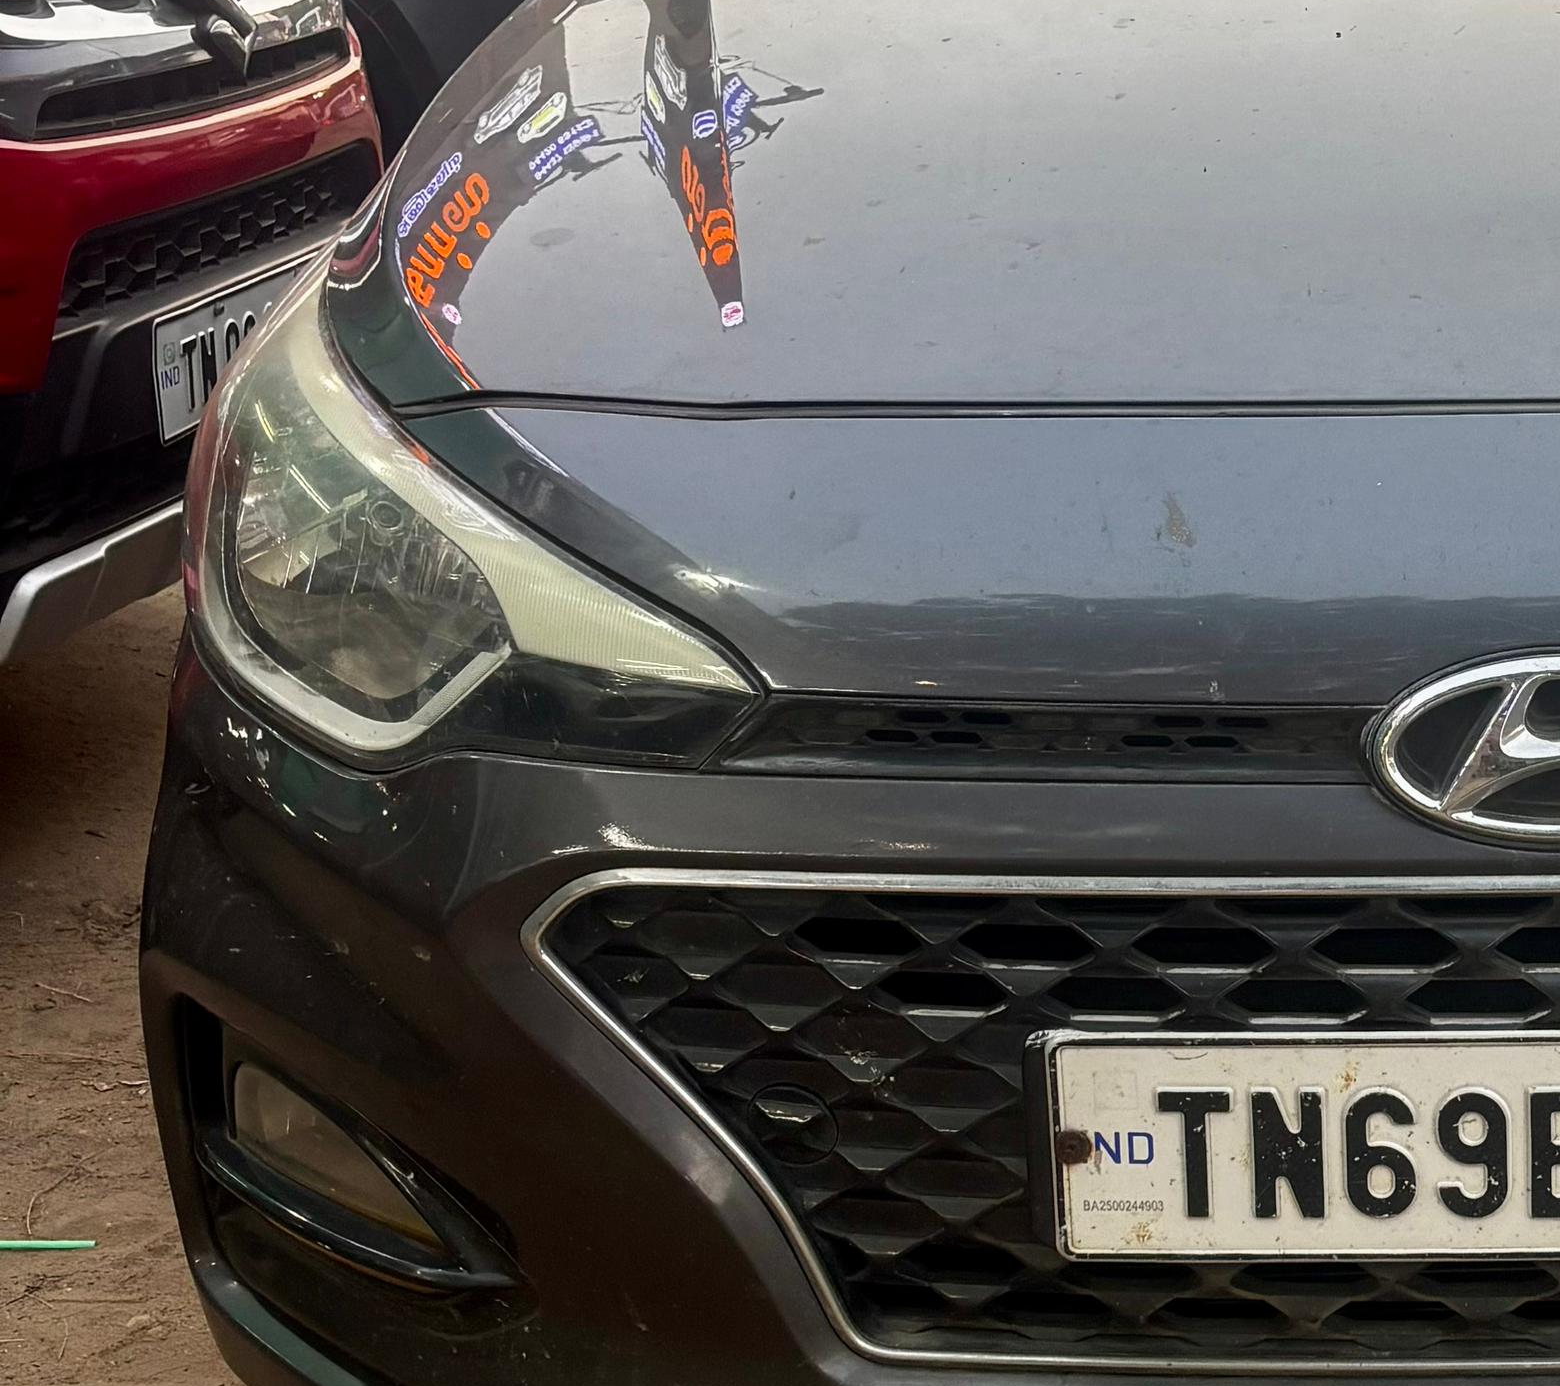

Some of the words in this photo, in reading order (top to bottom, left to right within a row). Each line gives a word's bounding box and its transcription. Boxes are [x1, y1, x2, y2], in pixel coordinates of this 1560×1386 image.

[160, 365, 180, 391] IND
[1084, 1131, 1155, 1165] ND
[1083, 1199, 1165, 1213] BA2500244903
